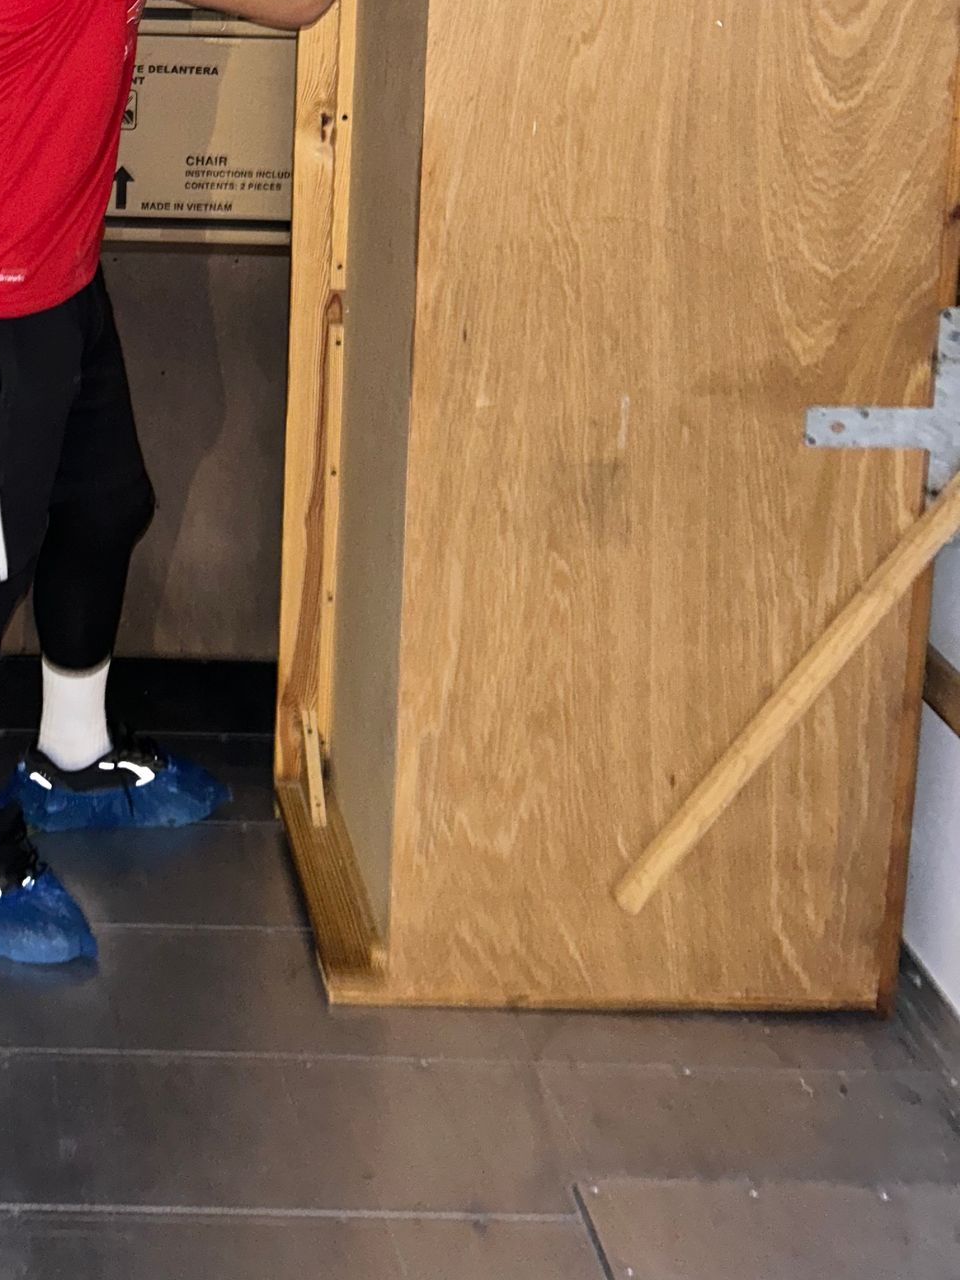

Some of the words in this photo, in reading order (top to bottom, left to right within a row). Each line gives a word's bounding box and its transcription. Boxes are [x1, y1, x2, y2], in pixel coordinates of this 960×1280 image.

[148, 65, 219, 75] DELANTERA
[185, 156, 228, 167] CHAIR
[185, 170, 254, 179] INSTRUCTIONS
[184, 182, 238, 191] CONTENTS:
[240, 183, 246, 191] 2
[248, 183, 282, 191] PIECES
[141, 202, 171, 211] MADE
[174, 203, 184, 211] IN
[186, 203, 233, 212] VIETNAM
